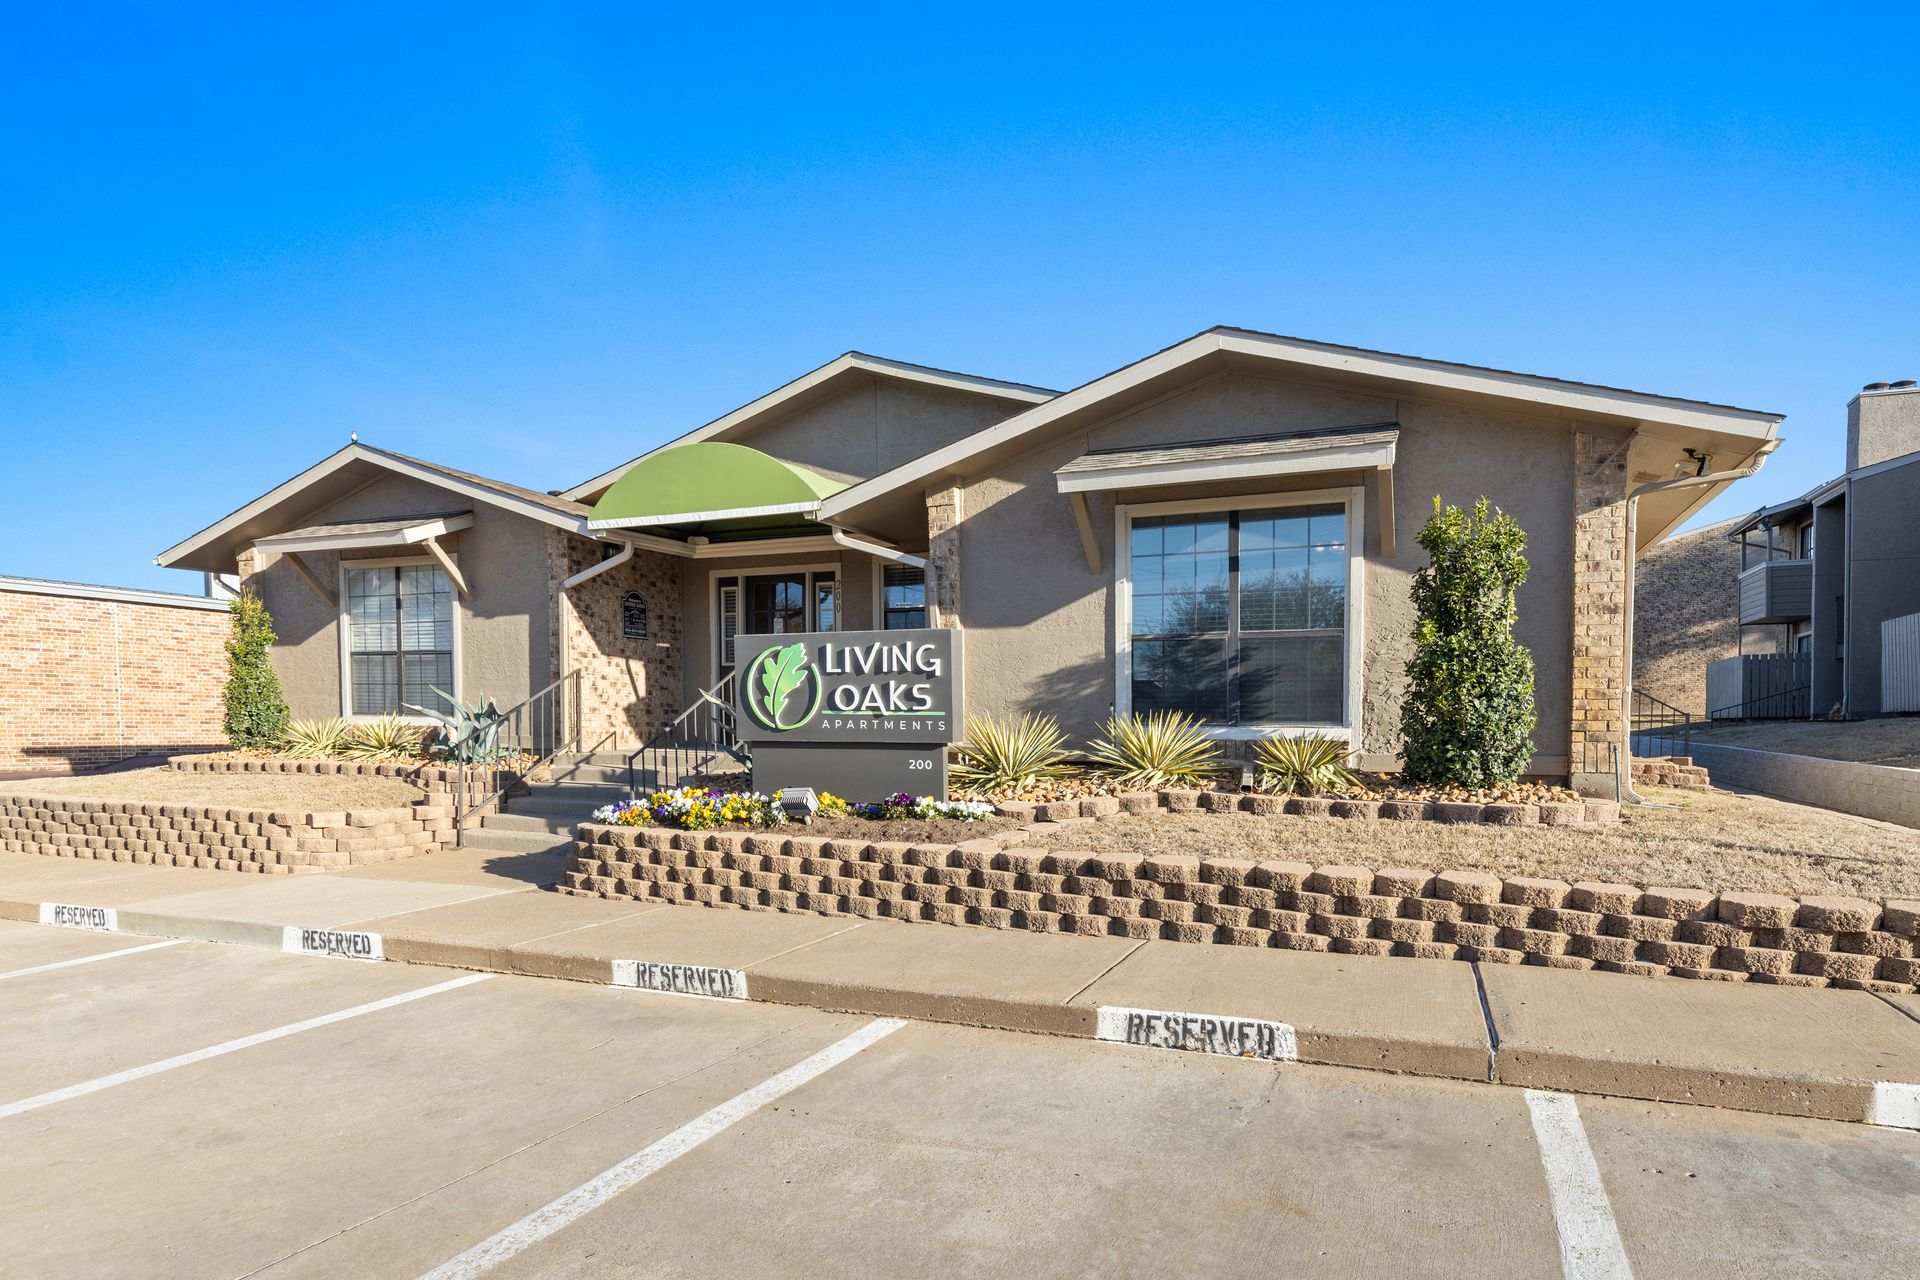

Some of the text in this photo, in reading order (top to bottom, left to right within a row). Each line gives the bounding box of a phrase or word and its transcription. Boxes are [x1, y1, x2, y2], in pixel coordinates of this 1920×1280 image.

[826, 641, 941, 676] LIVING
[834, 680, 932, 715] OAKS
[822, 719, 946, 731] APARTMENTS
[908, 759, 933, 770] 200
[54, 905, 106, 927] RESERVED
[302, 930, 372, 955] RESERVED
[635, 962, 734, 997] RESERVED
[1126, 1013, 1275, 1056] RESERVED
